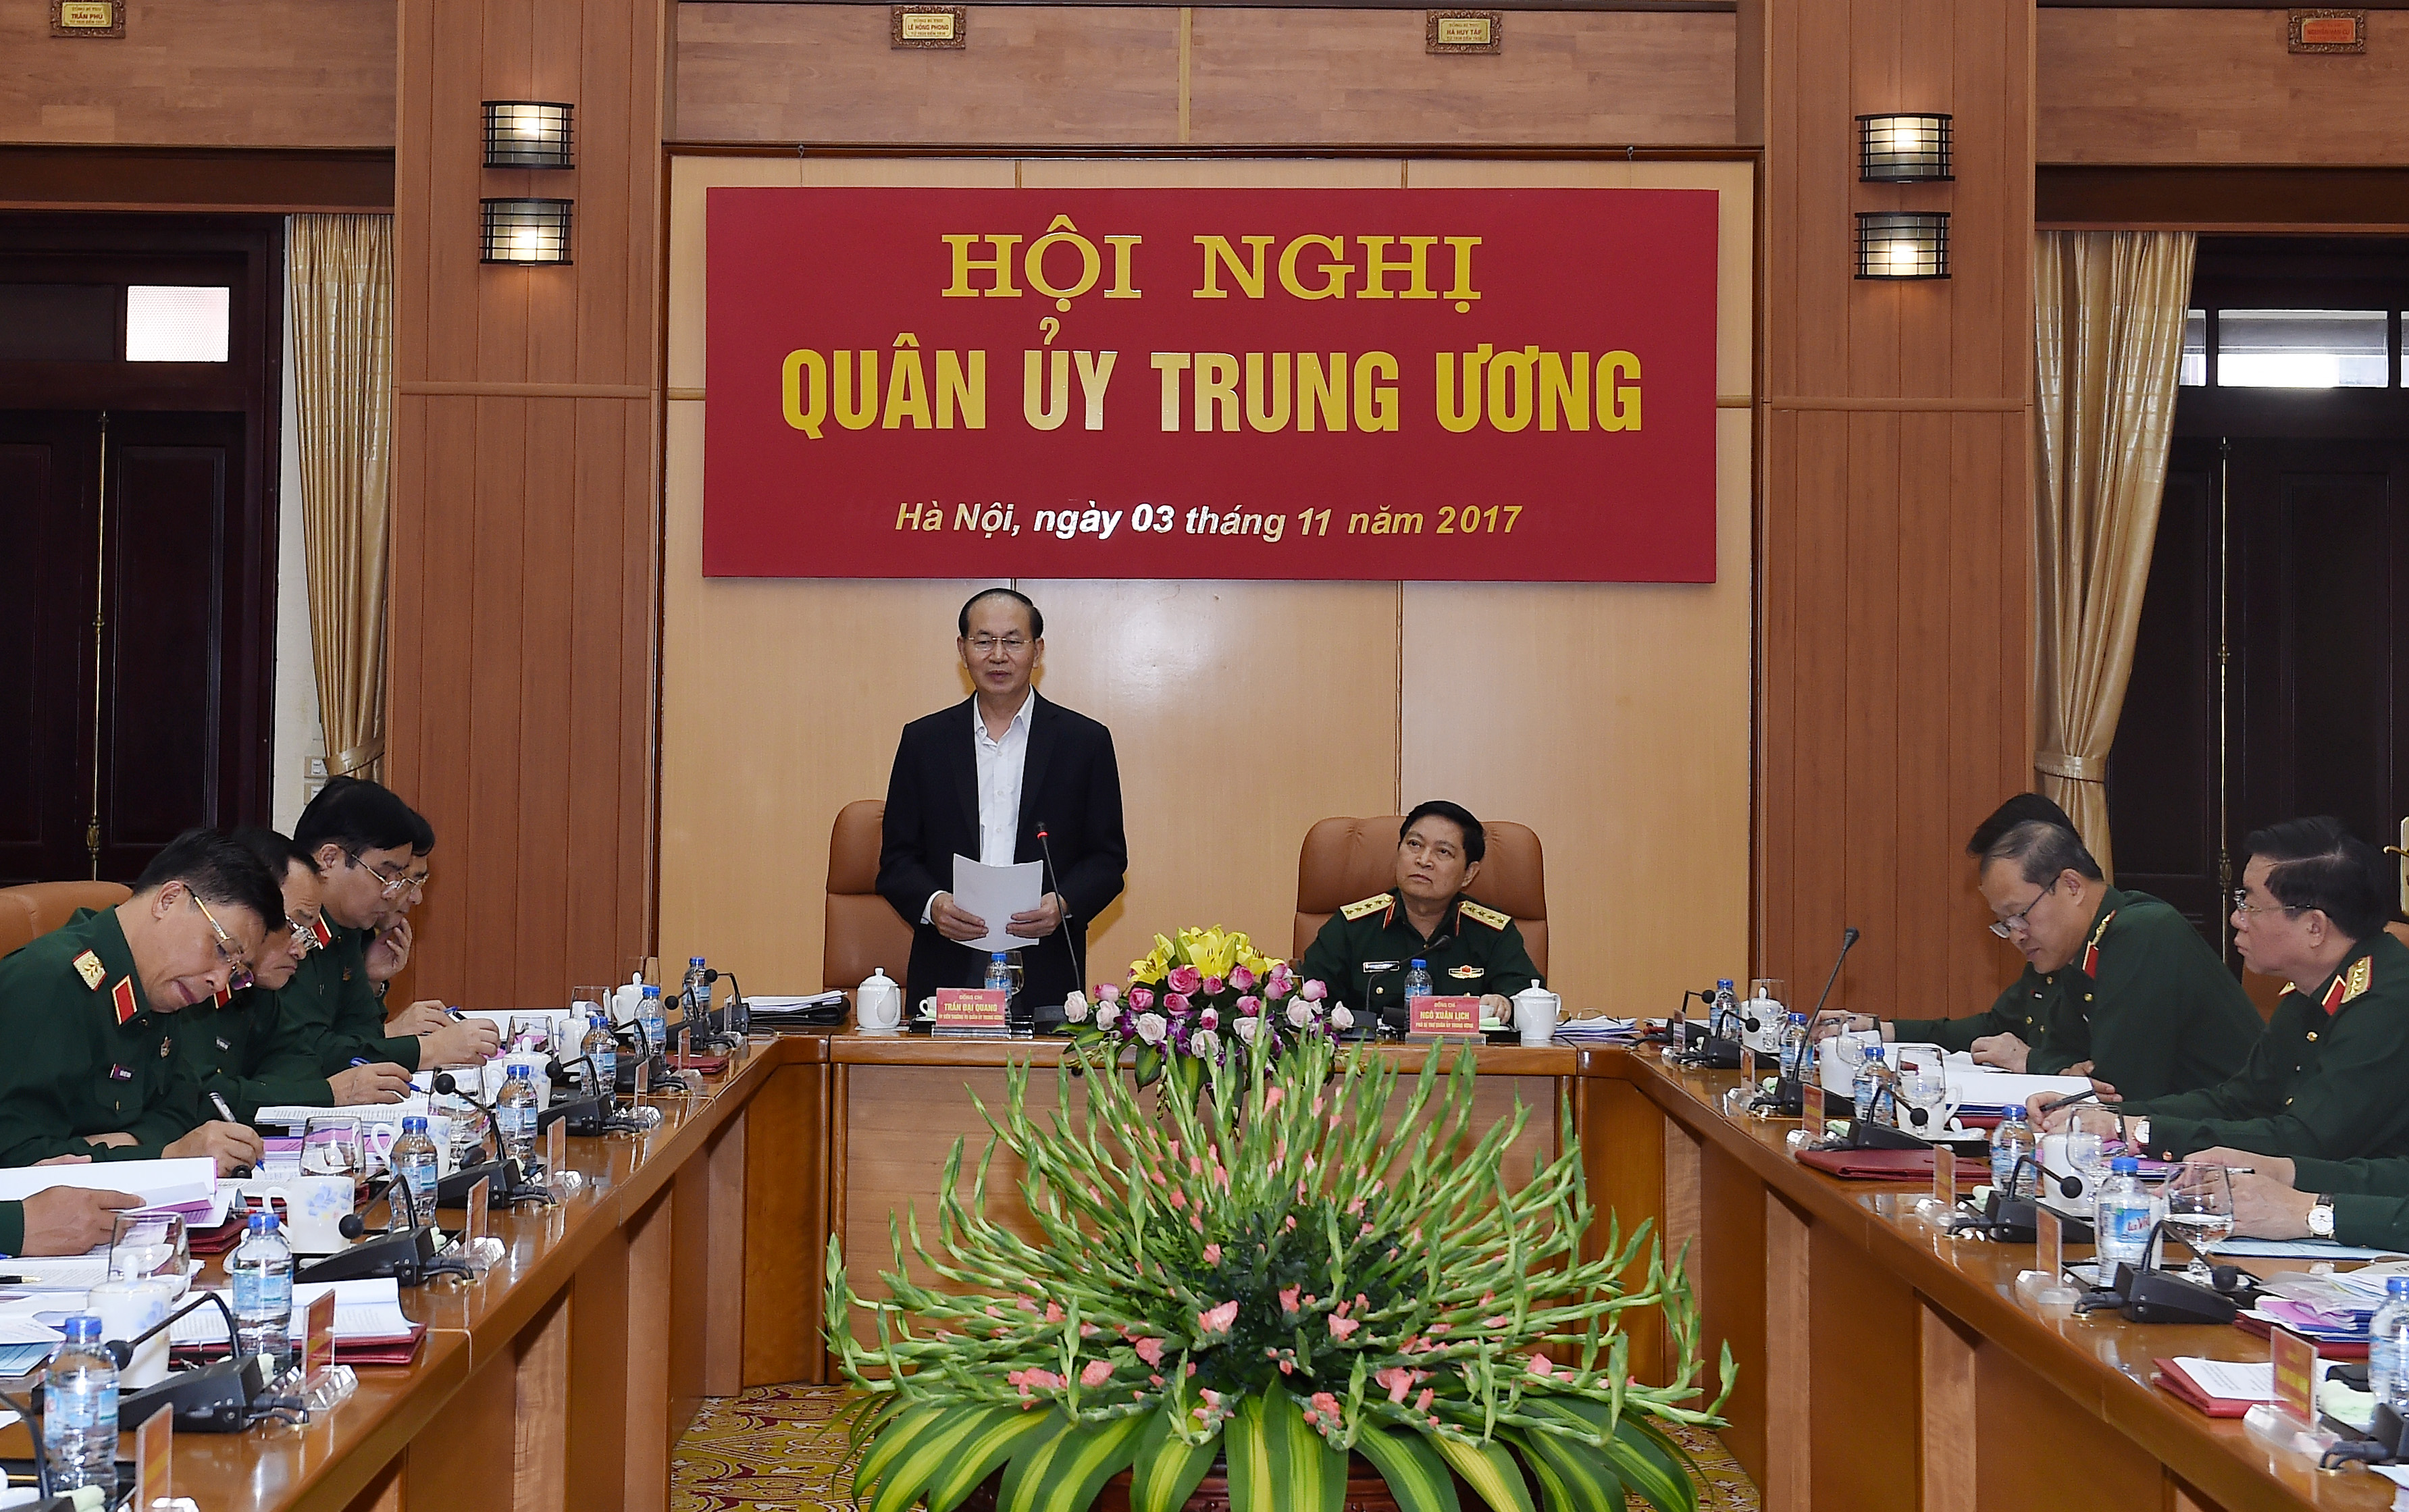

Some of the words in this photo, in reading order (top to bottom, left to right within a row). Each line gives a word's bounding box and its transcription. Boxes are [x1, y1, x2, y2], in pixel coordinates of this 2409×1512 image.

[941, 215, 1141, 312] HỘI
[1193, 234, 1482, 313] NGHỊ
[782, 333, 985, 439] QUÂN
[1024, 317, 1118, 430] ỦY
[1151, 351, 1398, 432] TRUNG
[1436, 344, 1641, 432] ƯƠNG
[896, 500, 943, 532] Hà
[954, 502, 1020, 538] Nội,
[1034, 500, 1122, 539] ngày
[1132, 504, 1175, 533] 03
[1186, 505, 1286, 542] tháng
[1298, 508, 1331, 536] 11
[1348, 504, 1423, 535] năm
[1436, 505, 1522, 534] 2017
[975, 1003, 998, 1012] QUANG
[1420, 1010, 1434, 1019] NGÔ
[1436, 1010, 1453, 1019] XUÂN
[1455, 1012, 1470, 1021] LỊCH
